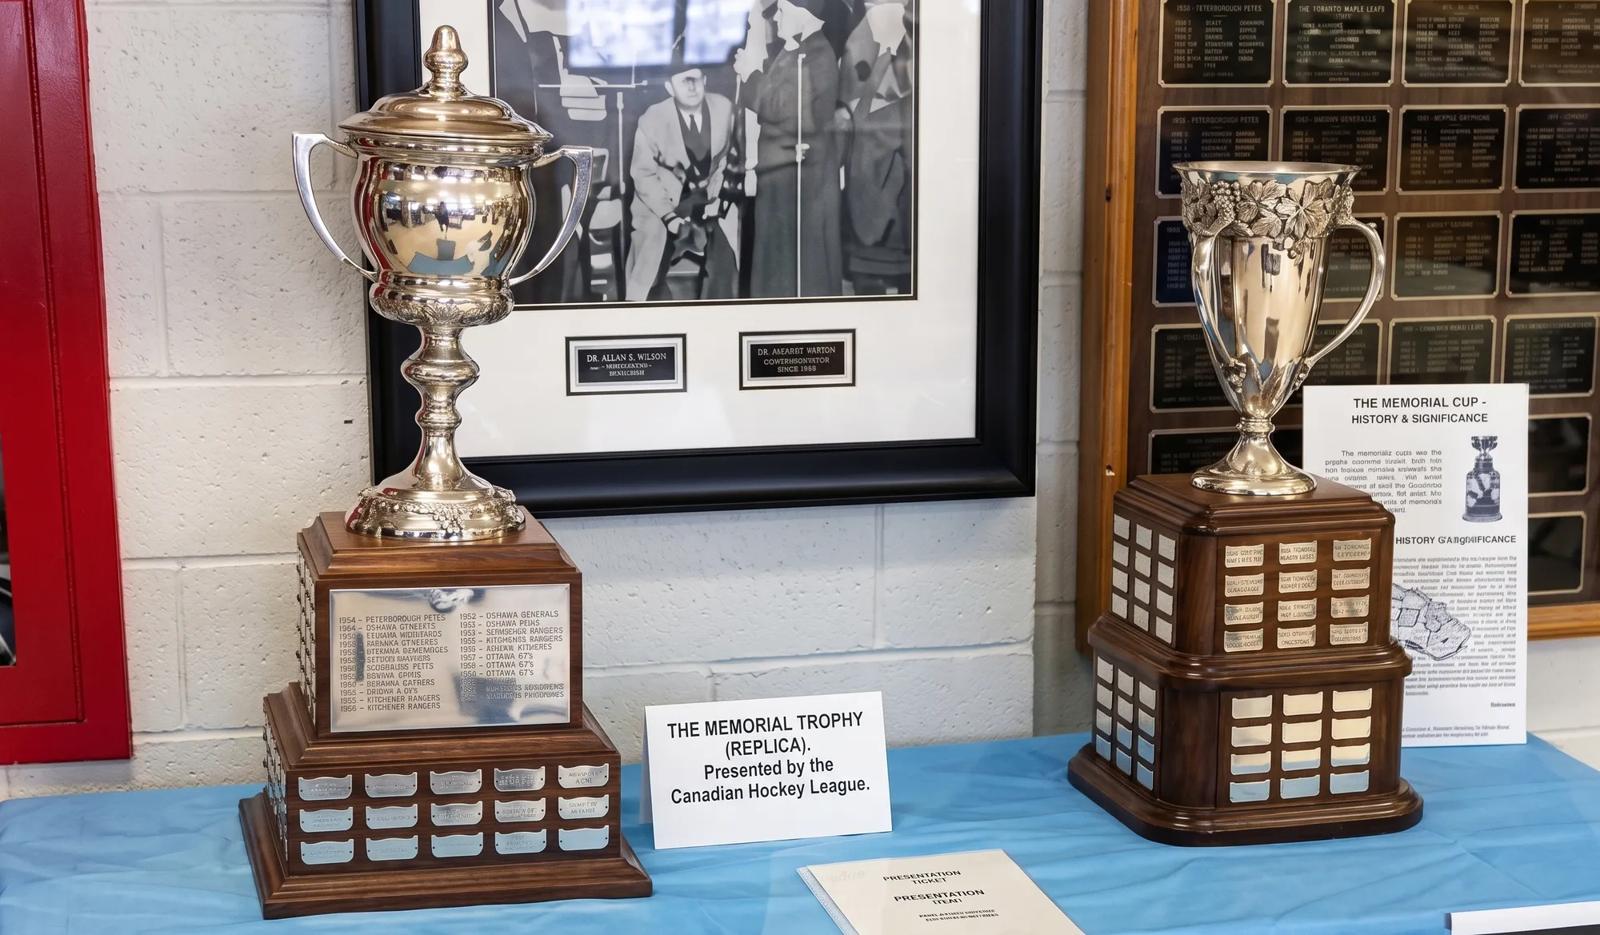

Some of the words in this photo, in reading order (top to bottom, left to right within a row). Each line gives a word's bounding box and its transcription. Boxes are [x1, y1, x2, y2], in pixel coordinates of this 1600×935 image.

[587, 354, 599, 362] DR.
[602, 353, 626, 362] ALLAN
[1353, 398, 1378, 408] THE
[1382, 397, 1449, 408] MEMORIAL
[1452, 397, 1479, 407] CUP
[1352, 414, 1399, 424] HISTORY
[1401, 414, 1409, 423] &
[1412, 413, 1488, 423] SIGNIFICANCE
[1396, 536, 1435, 544] HISTORY
[667, 721, 700, 739] THE
[705, 716, 793, 736] MEMORIAL
[797, 711, 863, 730] TROPHY
[726, 737, 811, 760] (REPLICA).
[704, 760, 782, 780] Presented
[787, 759, 805, 778] by
[810, 757, 834, 772] the
[671, 785, 744, 804] Canadian
[749, 782, 805, 800] Hockey
[810, 777, 870, 796] League.
[882, 870, 962, 881] PRESENTATION
[894, 889, 985, 902] PRESENTATION
